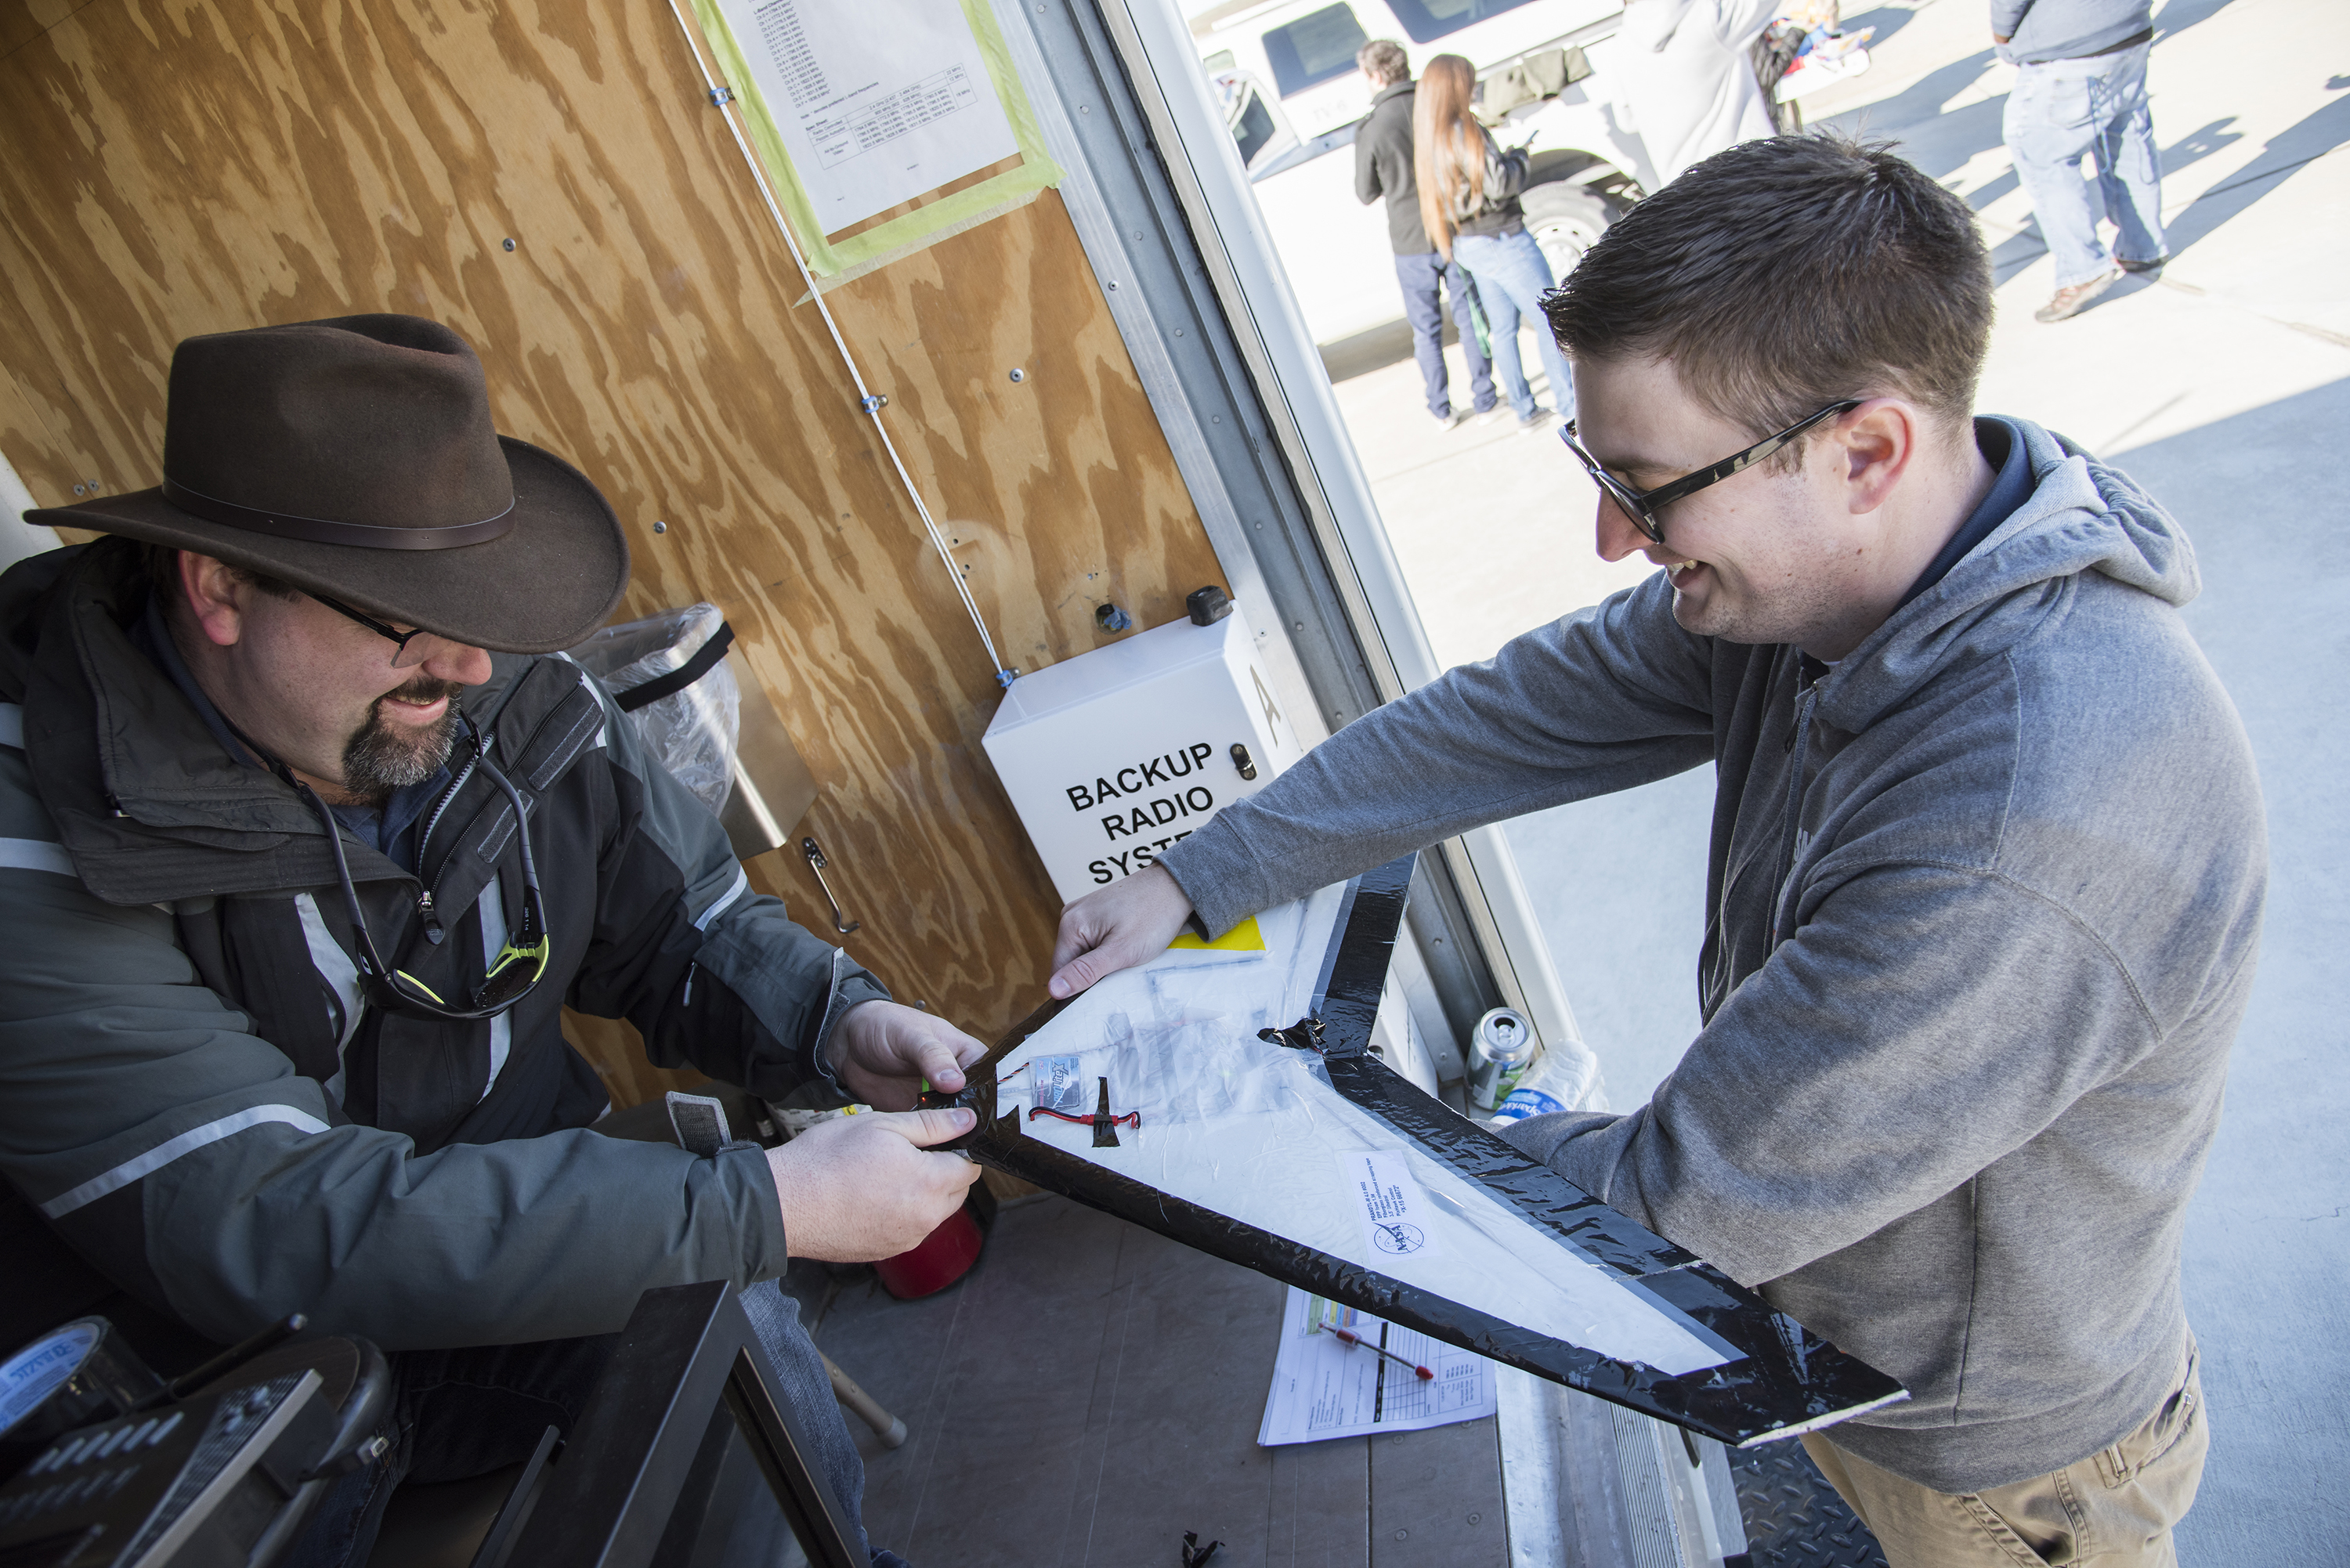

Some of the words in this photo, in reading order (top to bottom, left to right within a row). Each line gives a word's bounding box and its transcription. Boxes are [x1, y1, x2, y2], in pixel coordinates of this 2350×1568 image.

[1065, 742, 1212, 811] BACKUP
[1101, 786, 1213, 841] RADIO
[1088, 827, 1202, 884] SYST
